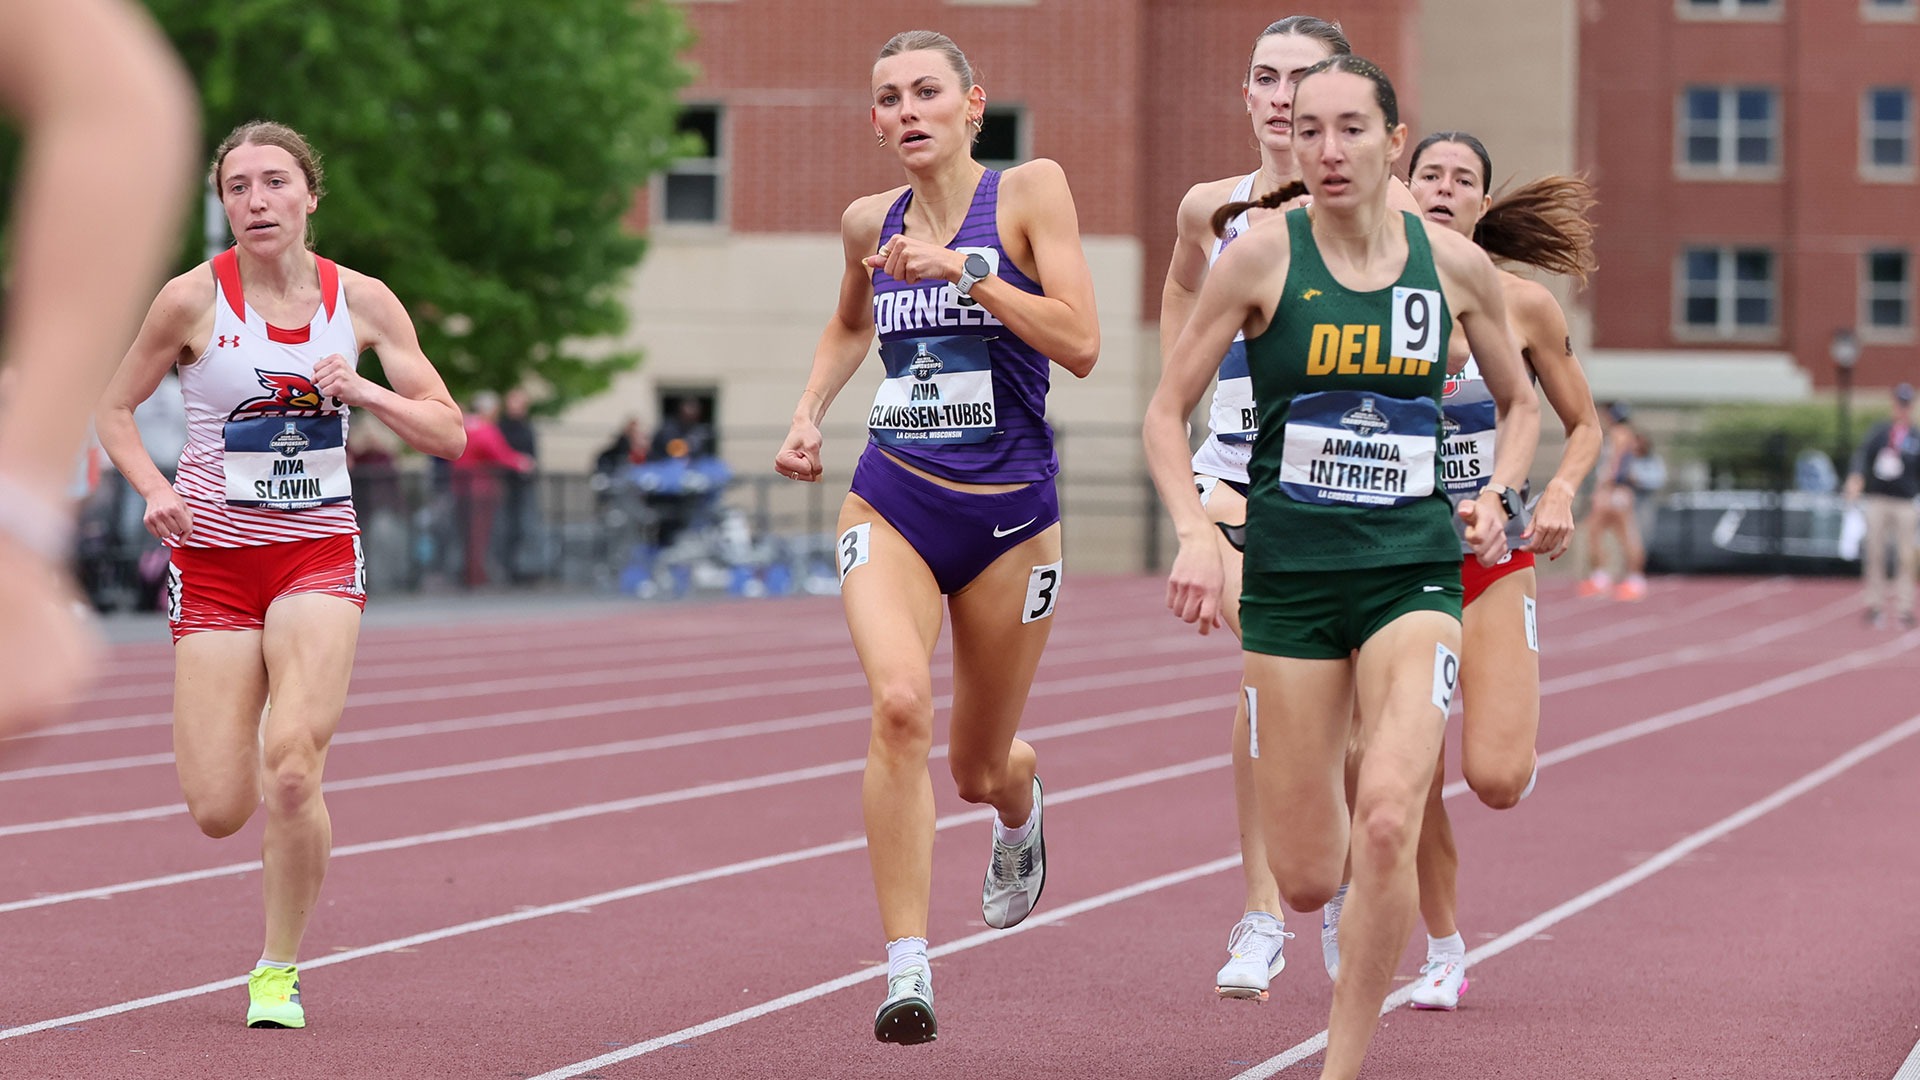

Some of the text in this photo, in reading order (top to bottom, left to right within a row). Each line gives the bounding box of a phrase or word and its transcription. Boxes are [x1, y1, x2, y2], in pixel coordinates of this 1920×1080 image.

[1405, 292, 1430, 351] 9
[1306, 324, 1431, 376] DEL
[911, 383, 940, 401] AVA
[869, 402, 993, 428] CLAUSSEN-TUBBS
[1321, 438, 1400, 462] AMANDA
[273, 459, 304, 476] MYA
[1309, 459, 1407, 493] INTRIERI
[254, 478, 322, 500] SLAVIN
[842, 531, 858, 577] 3
[1030, 570, 1057, 618] 3
